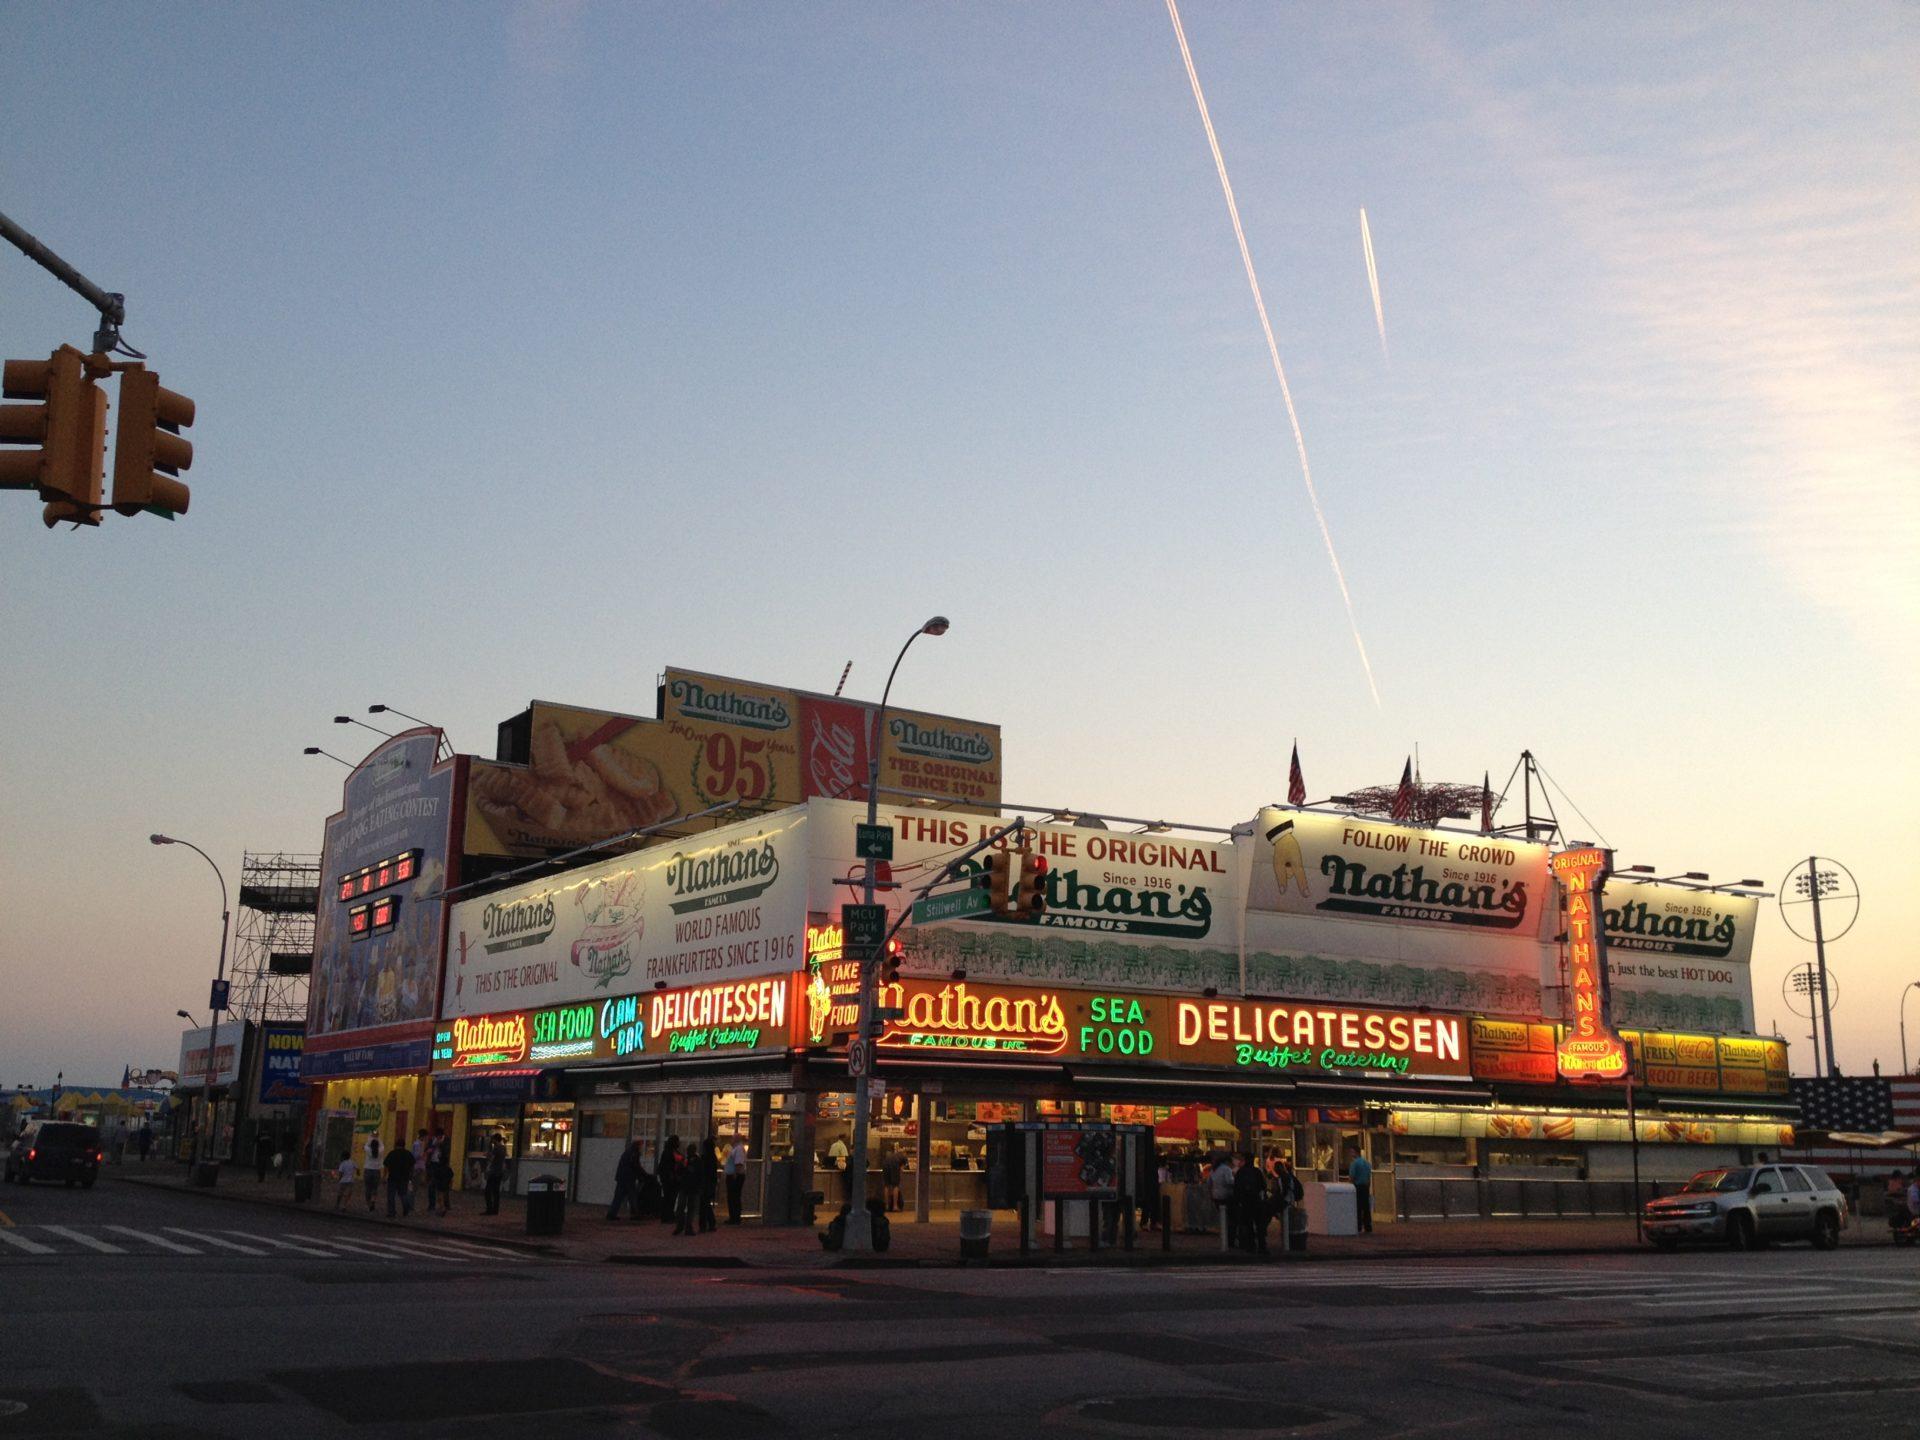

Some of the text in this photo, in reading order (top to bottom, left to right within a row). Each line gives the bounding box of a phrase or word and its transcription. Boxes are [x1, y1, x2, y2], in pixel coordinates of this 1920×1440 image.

[671, 680, 790, 723] Nathan's
[889, 718, 992, 756] Nathan's
[705, 732, 766, 798] 95
[888, 756, 997, 785] THE ORIGINAL
[901, 773, 985, 797] SINCE 1916
[399, 796, 440, 818] CONTEST
[876, 829, 891, 841] Park
[894, 814, 1227, 875] THIS IS THE ORIGINAL
[1342, 828, 1516, 867] FOLLOW THE CROWD
[667, 830, 778, 896] Nathan's
[1552, 850, 1602, 871] ORIGINAL
[1103, 871, 1172, 890] Since 1916
[1320, 854, 1528, 913] Nathan's
[1442, 868, 1498, 884] Since 1916
[950, 857, 1212, 922] Nthan's
[483, 889, 556, 939] Nathan's
[850, 908, 877, 920] MCU
[926, 897, 978, 917] Stillwell Av
[1380, 905, 1454, 922] FAMOUS
[1664, 902, 1712, 917] Since 1916
[675, 906, 761, 945] WORLD FAMOUS
[850, 921, 878, 933] Park
[1039, 915, 1129, 933] FAMOUS
[1603, 899, 1736, 943] athan's
[646, 934, 795, 980] FRANKFURTERS SINCE 1916
[1569, 871, 1596, 1037] NATHANS
[1612, 937, 1677, 953] FAMOUS
[475, 961, 559, 995] THIS IS THE ORIGINAL
[831, 962, 860, 982] TAKE
[1617, 960, 1637, 976] just
[1639, 964, 1656, 978] the
[1657, 965, 1679, 980] best
[1680, 967, 1706, 982] HOT
[1707, 969, 1733, 984] DOG
[600, 996, 637, 1039] CLAM
[651, 980, 786, 1038] DELICATESSEN
[830, 1004, 859, 1026] FOOD
[1090, 998, 1144, 1024] SEA
[436, 1031, 451, 1043] OPEN
[453, 1014, 526, 1052] Nathan's
[533, 1005, 594, 1043] SEA FOOD
[1177, 1002, 1460, 1061] DELICATESSEN
[1473, 1023, 1526, 1042] Nathan's
[616, 1020, 645, 1056] BAR
[669, 1024, 760, 1053] Buffet Catering
[910, 1033, 996, 1049] FAMOUS
[1080, 1027, 1154, 1055] FOOD
[1572, 1044, 1605, 1052] FAMOUS
[1719, 1042, 1763, 1058] Nathan's
[440, 1047, 453, 1059] YEAR
[1236, 1043, 1410, 1073] Buffet Catering
[1645, 1046, 1675, 1060] FRIES
[1647, 1068, 1686, 1084] ROOT
[1688, 1070, 1718, 1086] BEER
